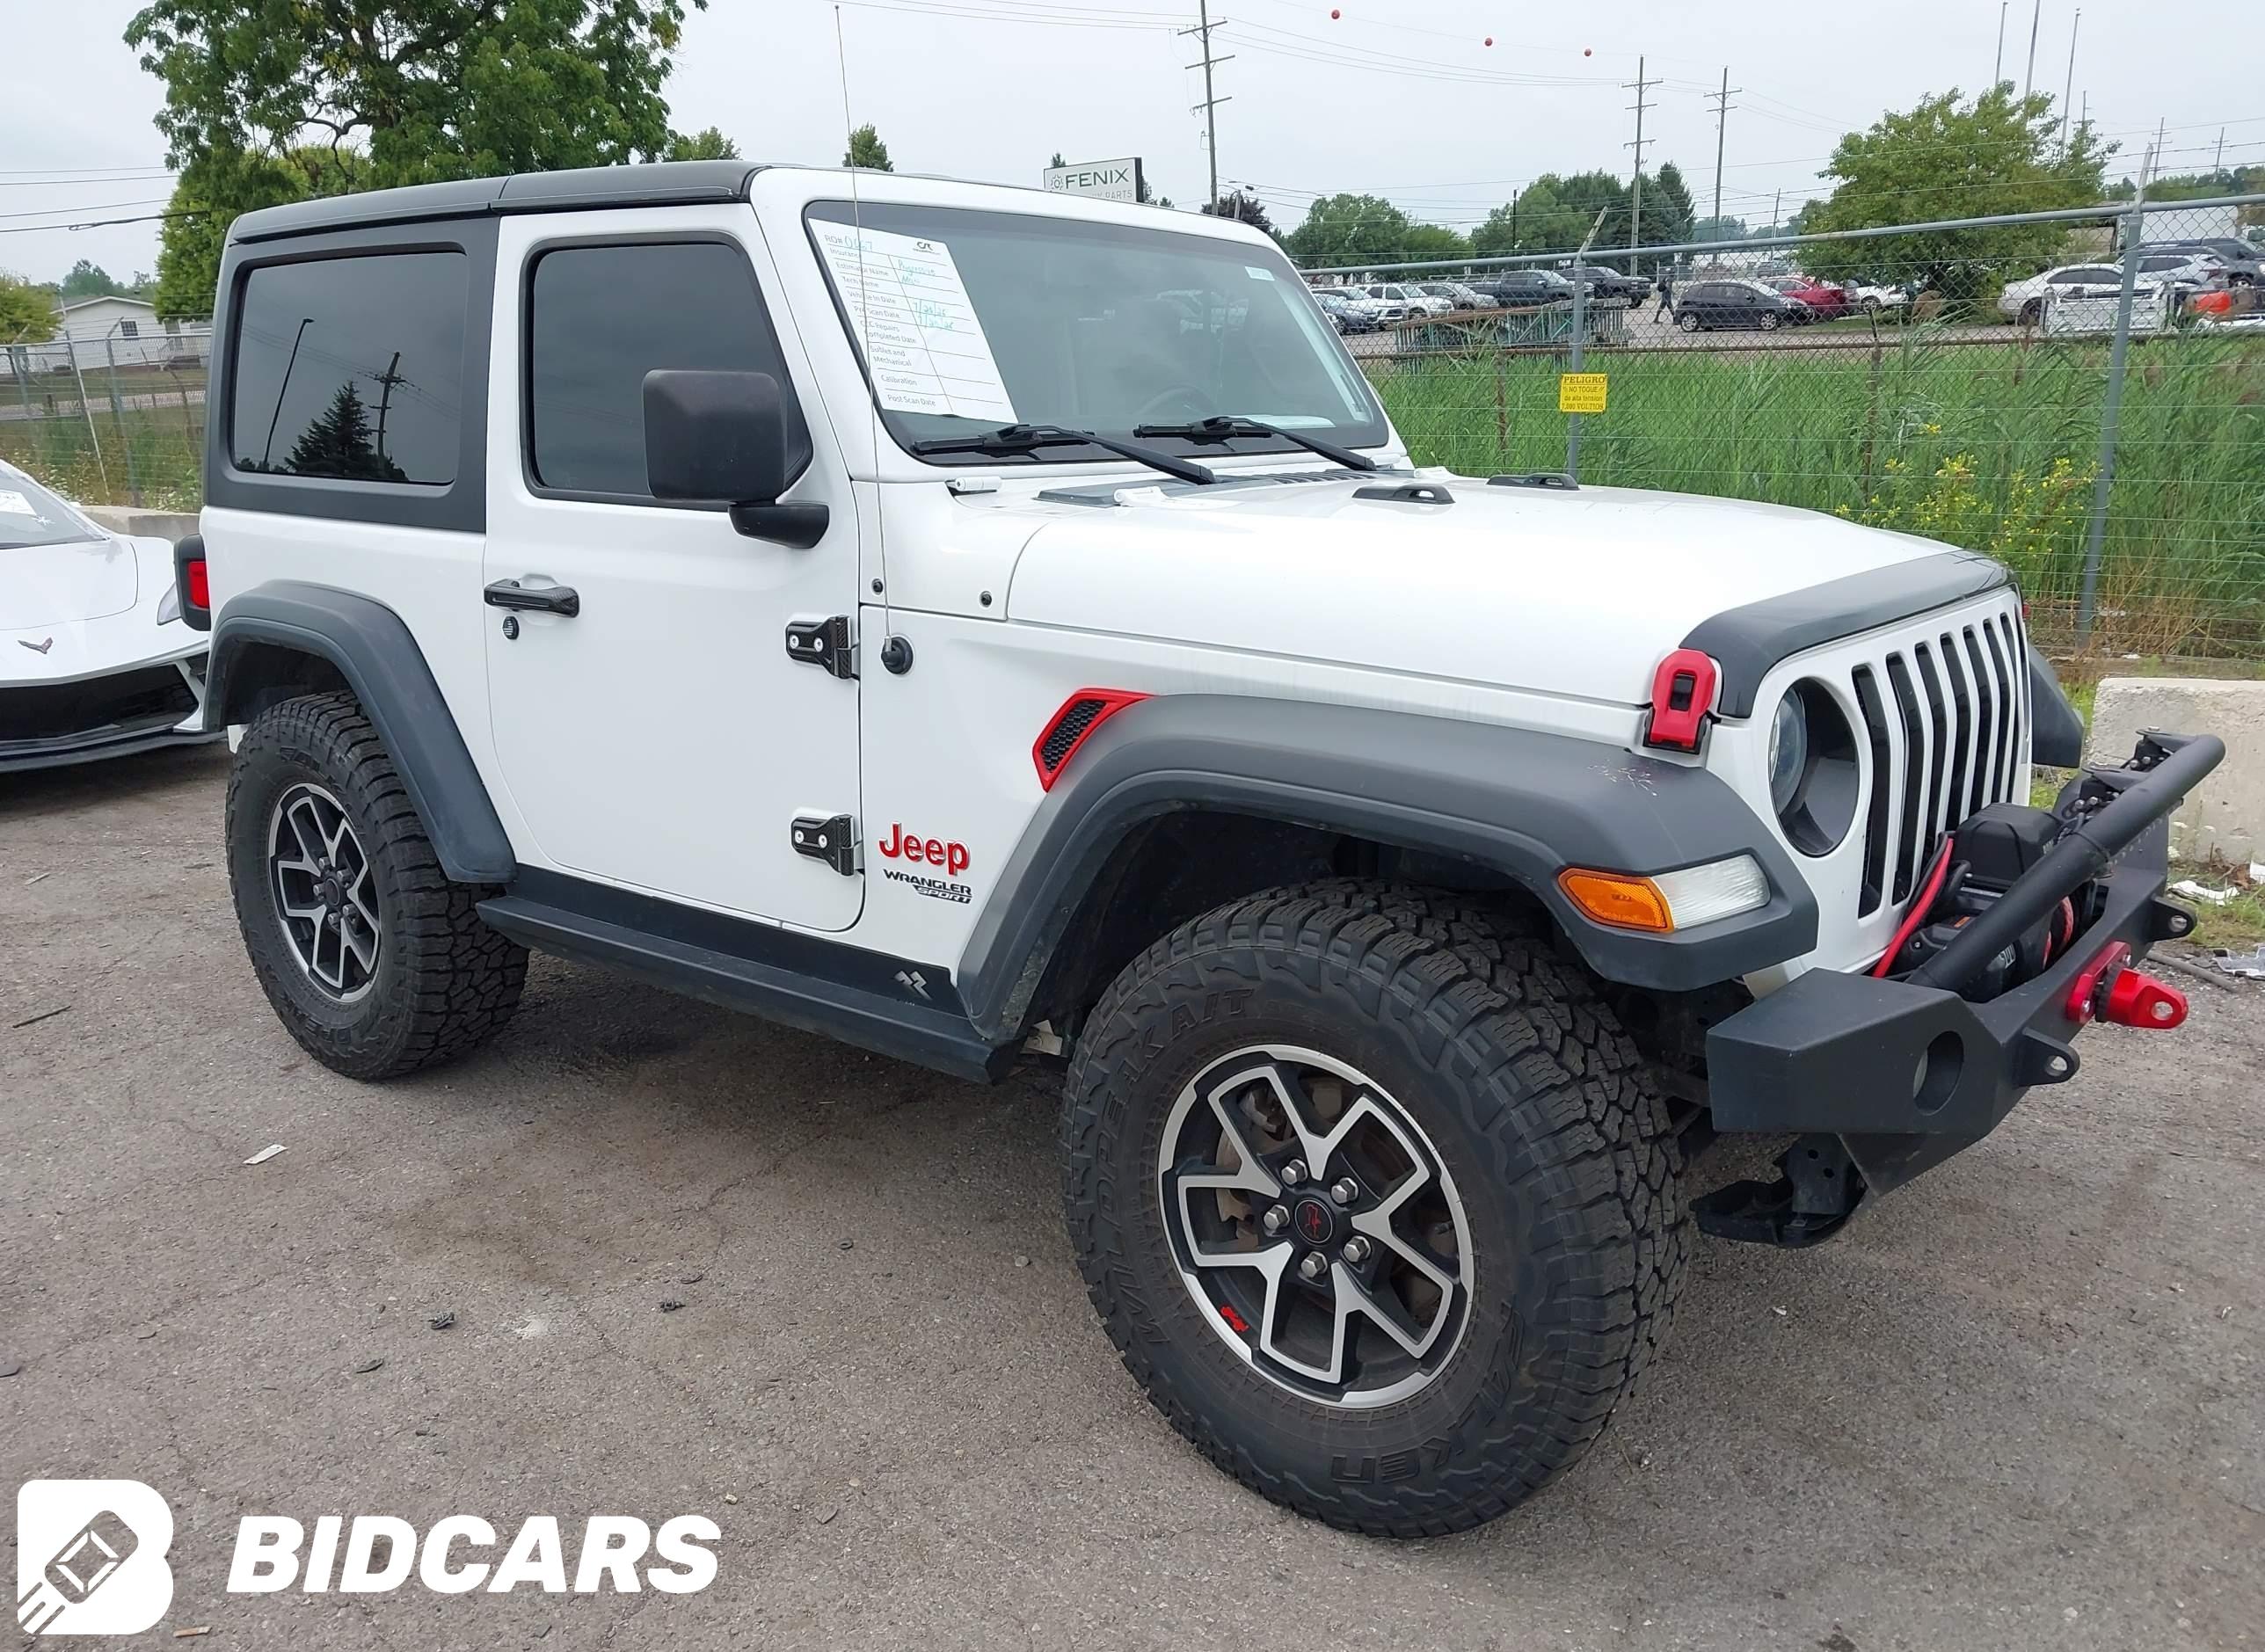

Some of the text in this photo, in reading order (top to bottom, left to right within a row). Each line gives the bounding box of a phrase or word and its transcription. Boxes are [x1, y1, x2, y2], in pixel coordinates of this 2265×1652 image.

[1065, 167, 1129, 189] FENIX
[880, 375, 918, 386] Calibration
[878, 822, 971, 877] Jeep
[883, 868, 972, 896] WRANGLER
[915, 885, 971, 903] SPORT
